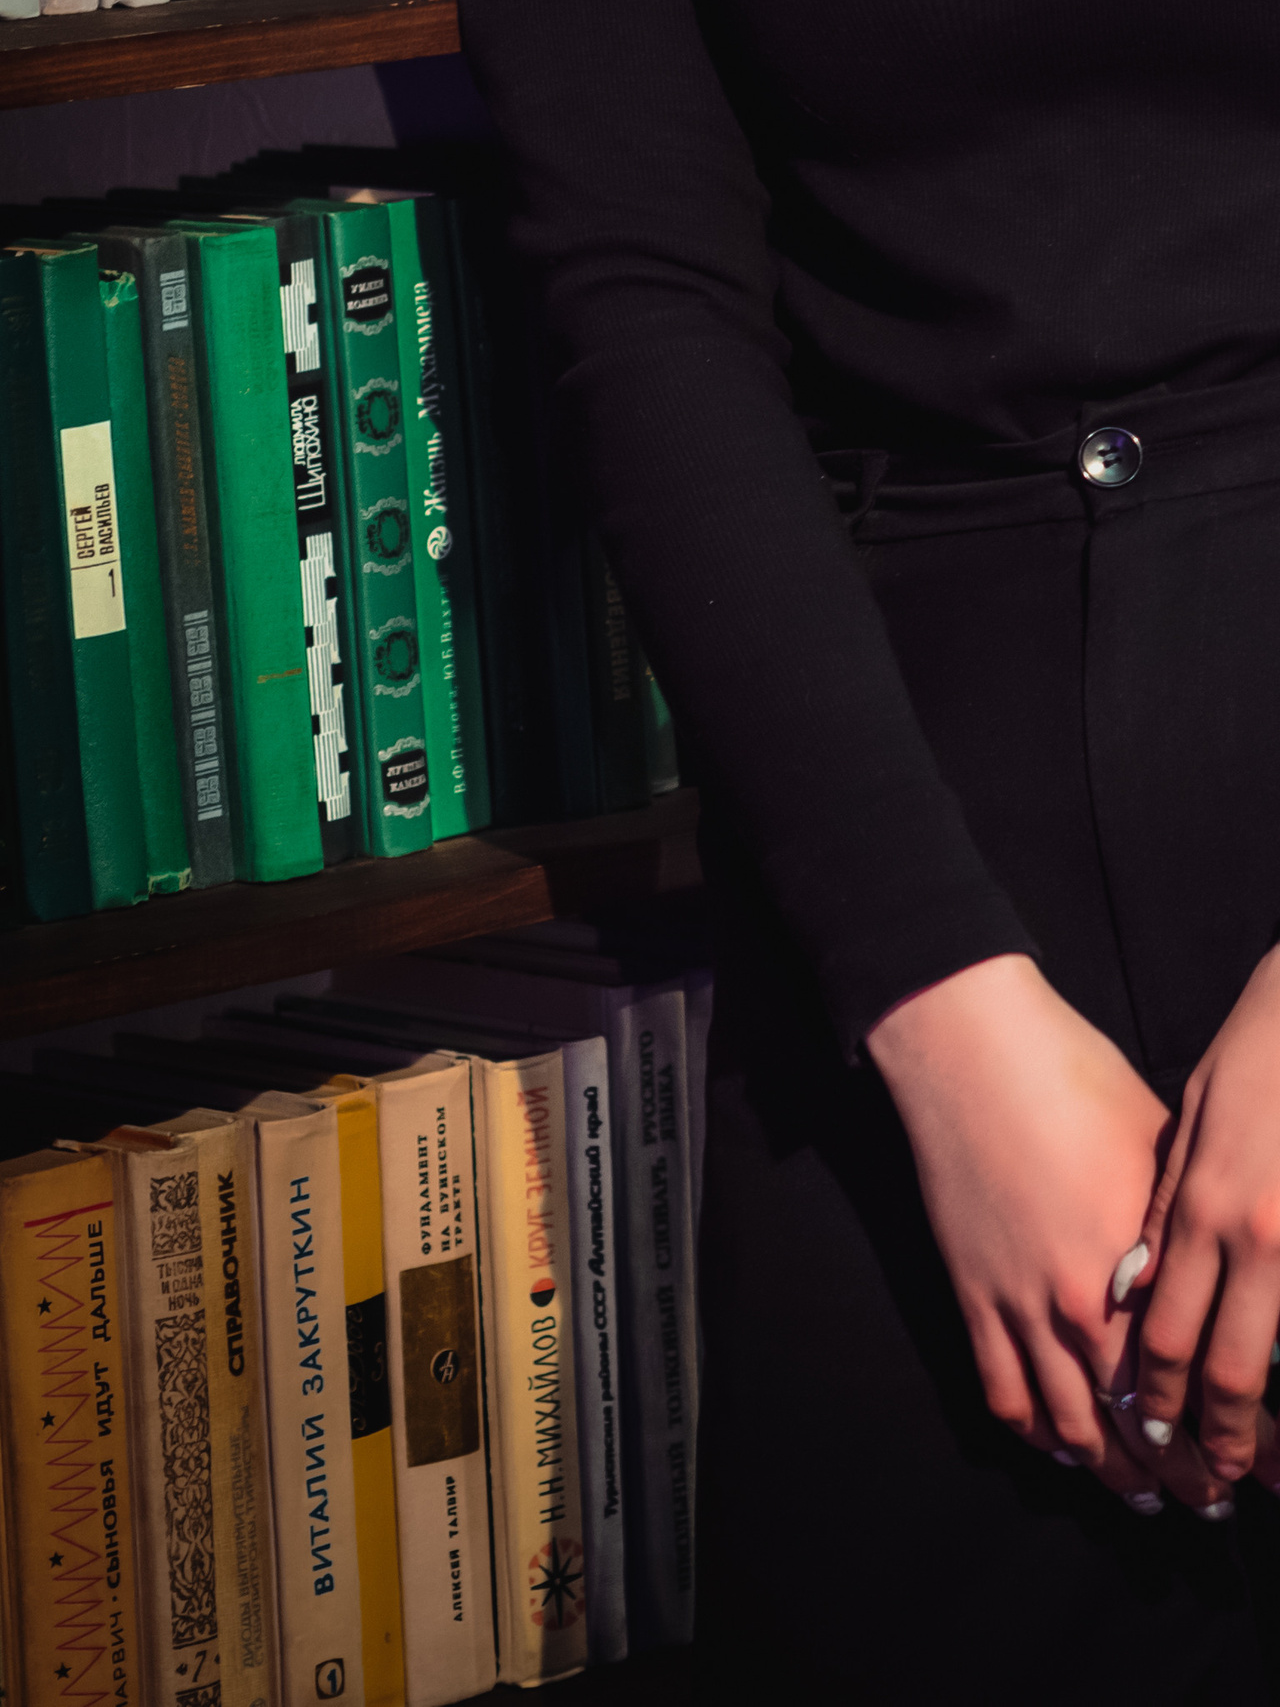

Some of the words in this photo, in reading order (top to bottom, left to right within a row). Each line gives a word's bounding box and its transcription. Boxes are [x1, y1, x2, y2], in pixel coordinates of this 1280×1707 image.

[413, 281, 446, 421] Мухаммеда
[290, 398, 306, 466] ЛЮДМИЛА
[296, 394, 327, 511] Щипахина
[422, 431, 448, 516] Жизнь
[69, 505, 96, 560] СЕРГЕЙ
[94, 482, 115, 557] ВАСИЛЬЕВ
[515, 1083, 552, 1197] ЗЕМНОЙ
[582, 1086, 604, 1140] край
[416, 1134, 432, 1256] ФУНДАМЕНТ
[435, 1105, 450, 1215] БУИНСКОМ
[439, 1224, 451, 1252] НА
[451, 1174, 463, 1247] ТРАКТЕ
[525, 1208, 557, 1270] КРУГ
[583, 1145, 606, 1278] Алтайский
[87, 1220, 112, 1342] ДАЛЬШЕ
[161, 1280, 170, 1294] И
[172, 1272, 204, 1293] ОДНА
[168, 1292, 200, 1311] НОЧЬ
[216, 1170, 246, 1378] СПРАВОЧНИК
[289, 1175, 325, 1396] ЗАКРУТКИН
[592, 1280, 609, 1331] СССР
[92, 1360, 116, 1437] ИДУТ
[527, 1316, 567, 1523] Н.Н.МИХАЙЛОВ
[99, 1458, 121, 1590] СЫНОВЬЯ
[301, 1412, 334, 1596] ВИТАЛИЙ
[192, 1649, 208, 1684] 7
[326, 1668, 337, 1694] 1
